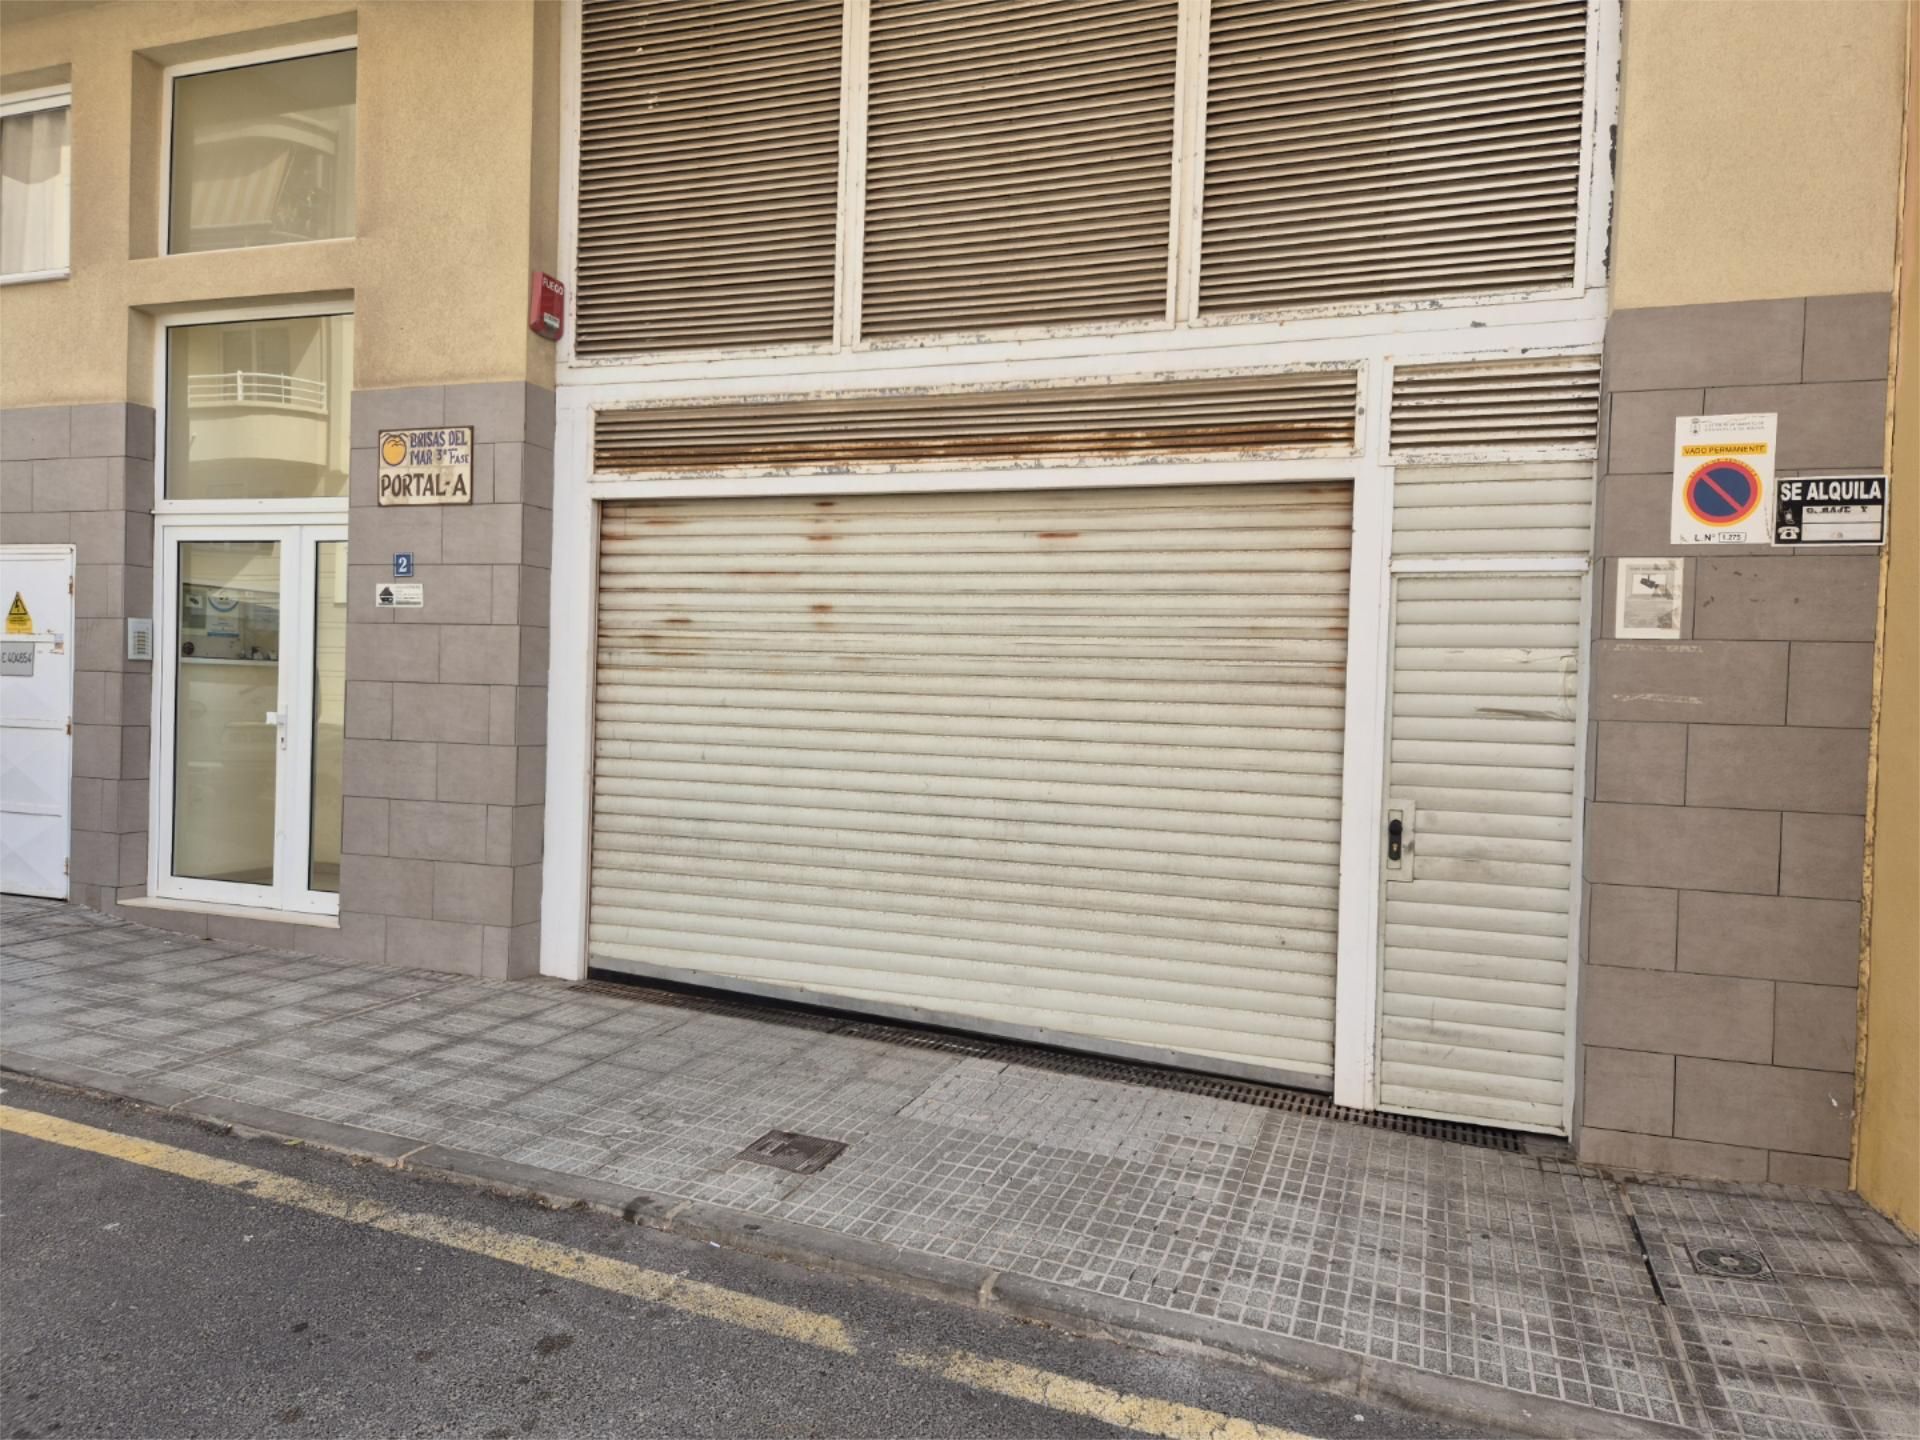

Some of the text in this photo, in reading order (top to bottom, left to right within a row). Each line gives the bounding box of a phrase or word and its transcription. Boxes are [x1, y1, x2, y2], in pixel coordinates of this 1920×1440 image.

[543, 277, 563, 296] FUEGO
[410, 430, 468, 448] BRISAS DEL
[410, 450, 433, 466] MAR
[1684, 444, 1766, 455] VADO PERMANENTE
[1780, 480, 1882, 501] SE ALQUILA
[397, 557, 408, 573] 2
